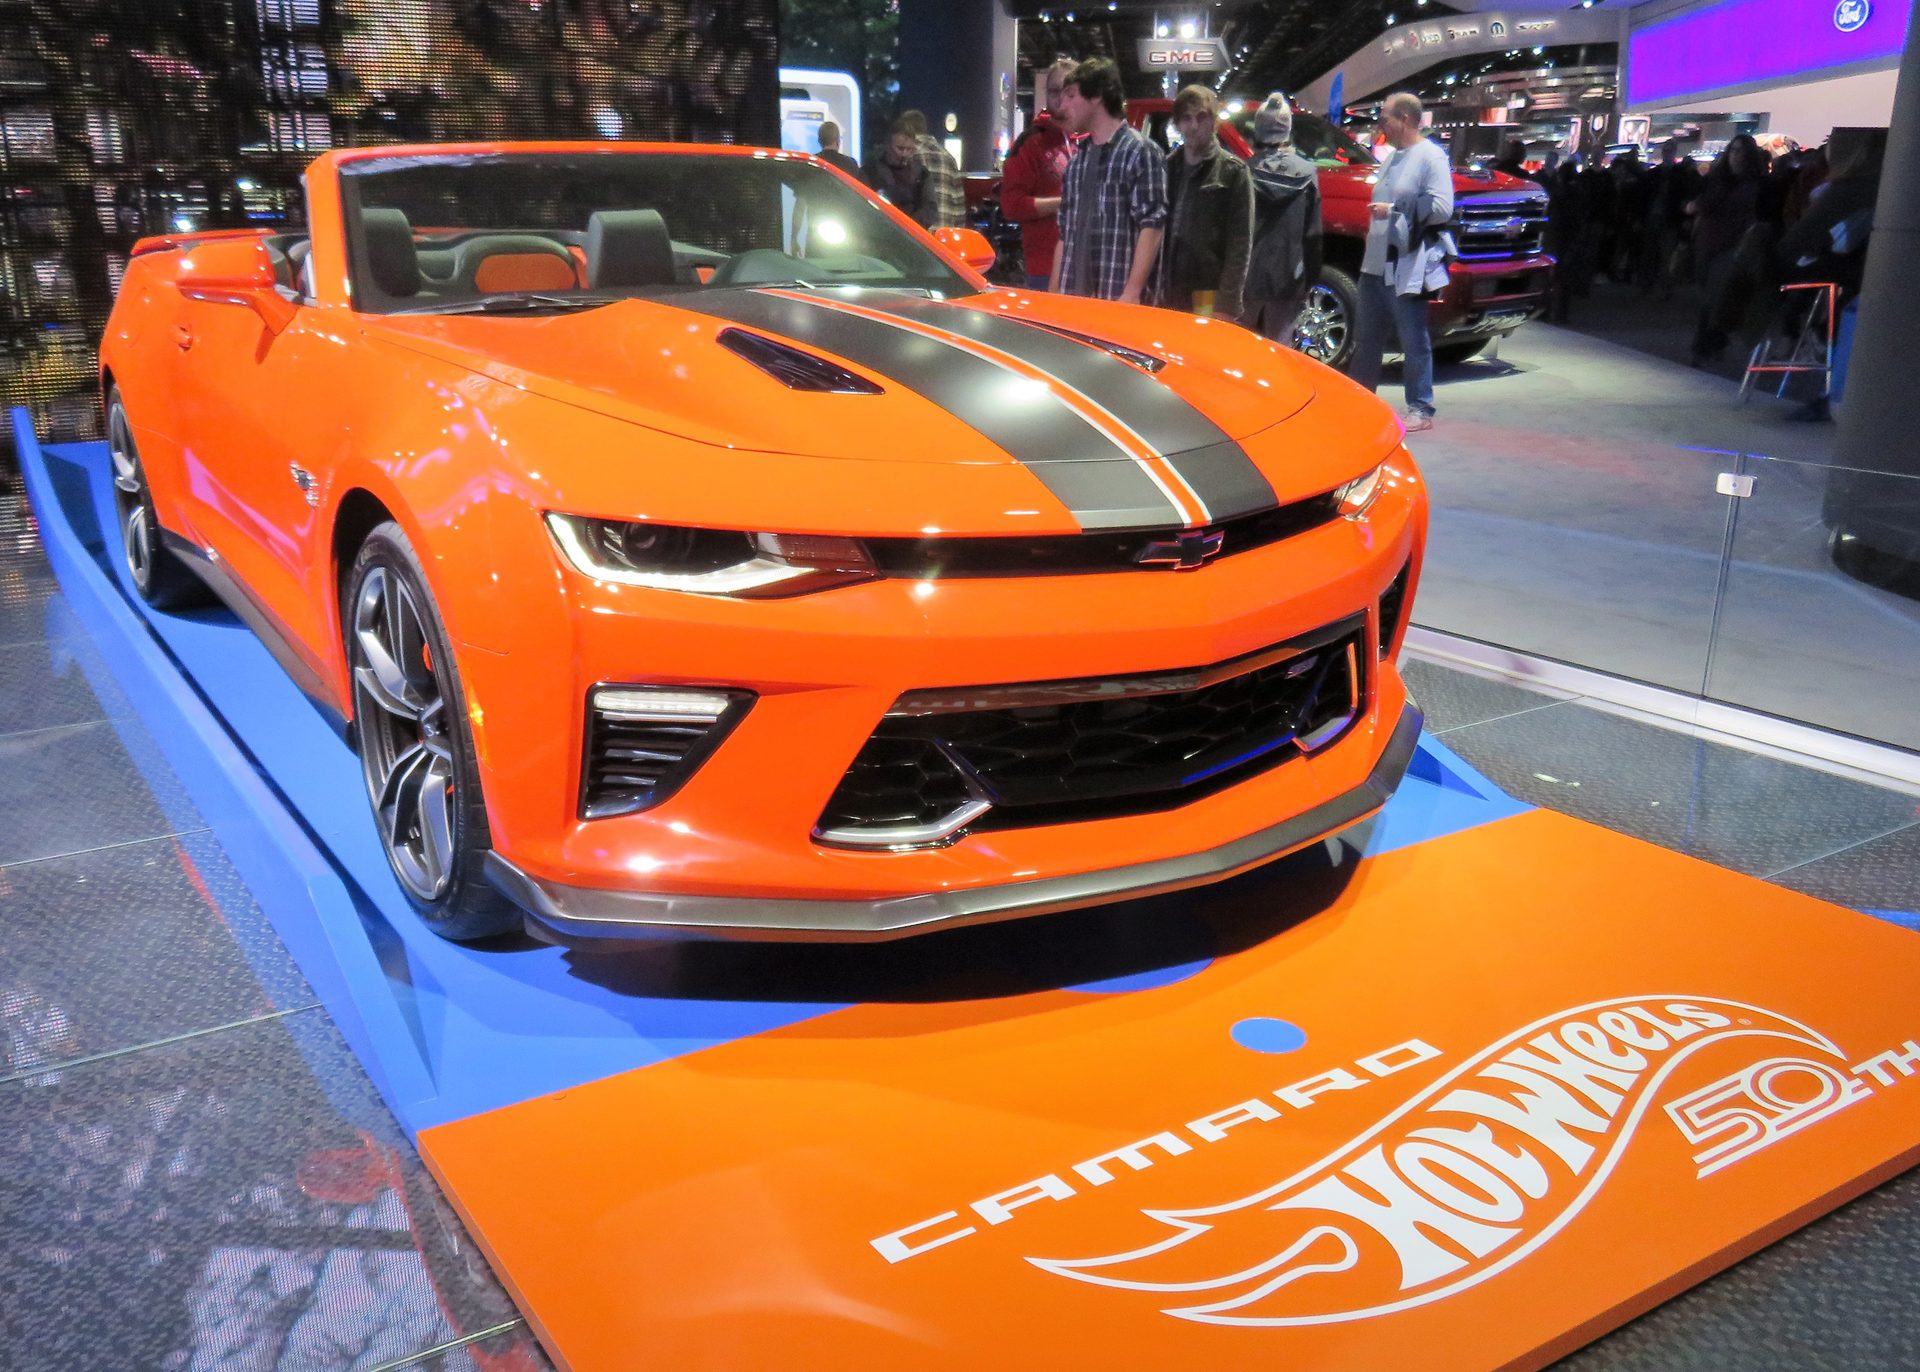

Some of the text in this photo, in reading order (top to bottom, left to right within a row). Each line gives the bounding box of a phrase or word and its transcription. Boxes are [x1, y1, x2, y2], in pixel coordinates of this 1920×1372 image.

[1838, 1, 1862, 25] Ford
[1149, 51, 1214, 64] GMC
[869, 1038, 1444, 1264] CAMARO
